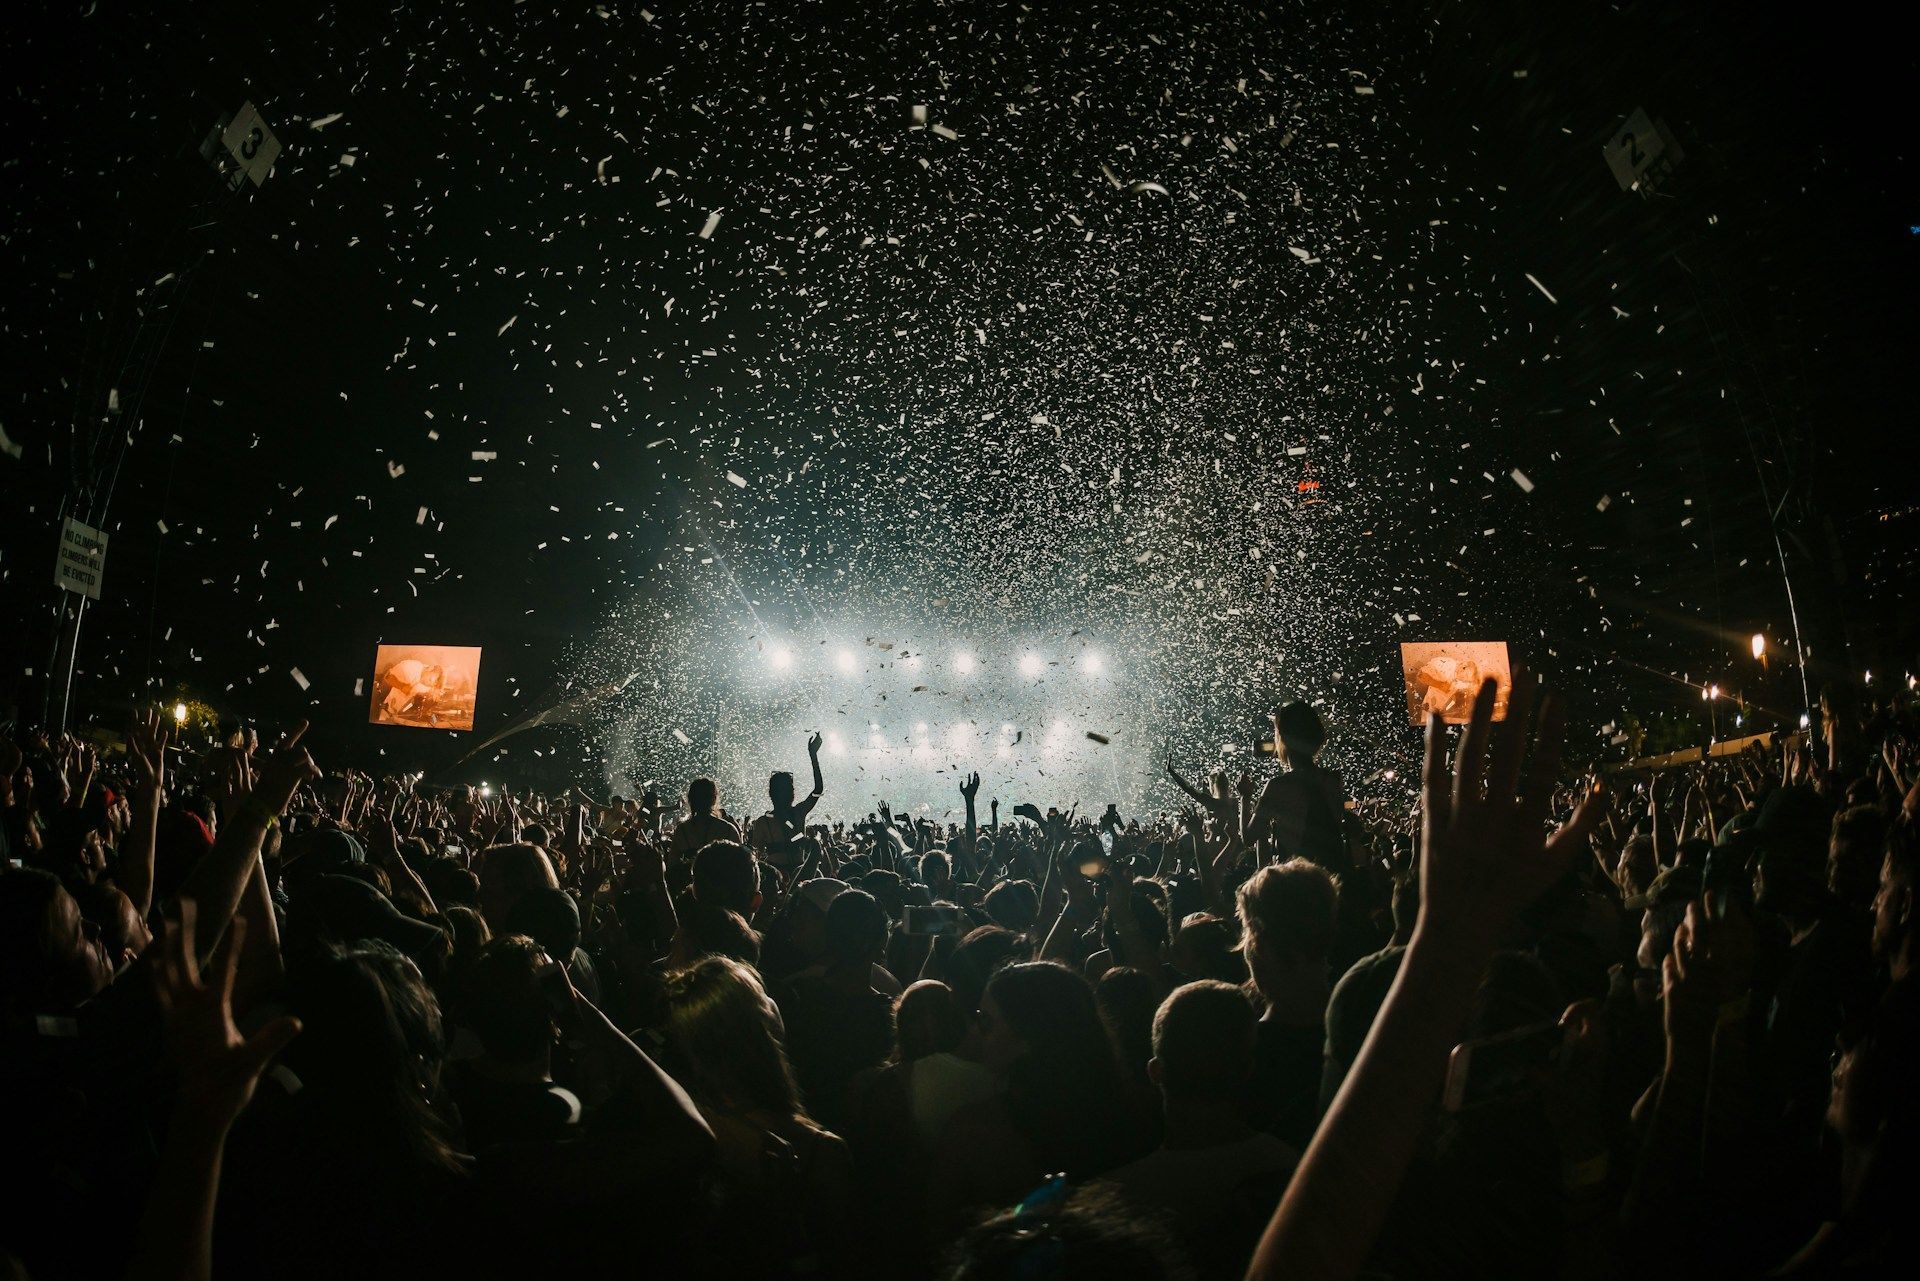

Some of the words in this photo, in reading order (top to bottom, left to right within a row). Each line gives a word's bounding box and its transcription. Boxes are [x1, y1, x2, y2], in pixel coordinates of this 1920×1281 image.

[241, 127, 264, 160] 3
[1621, 133, 1646, 167] 2
[64, 528, 75, 543] NO
[63, 563, 72, 577] BE
[71, 568, 96, 586] EVICTED
